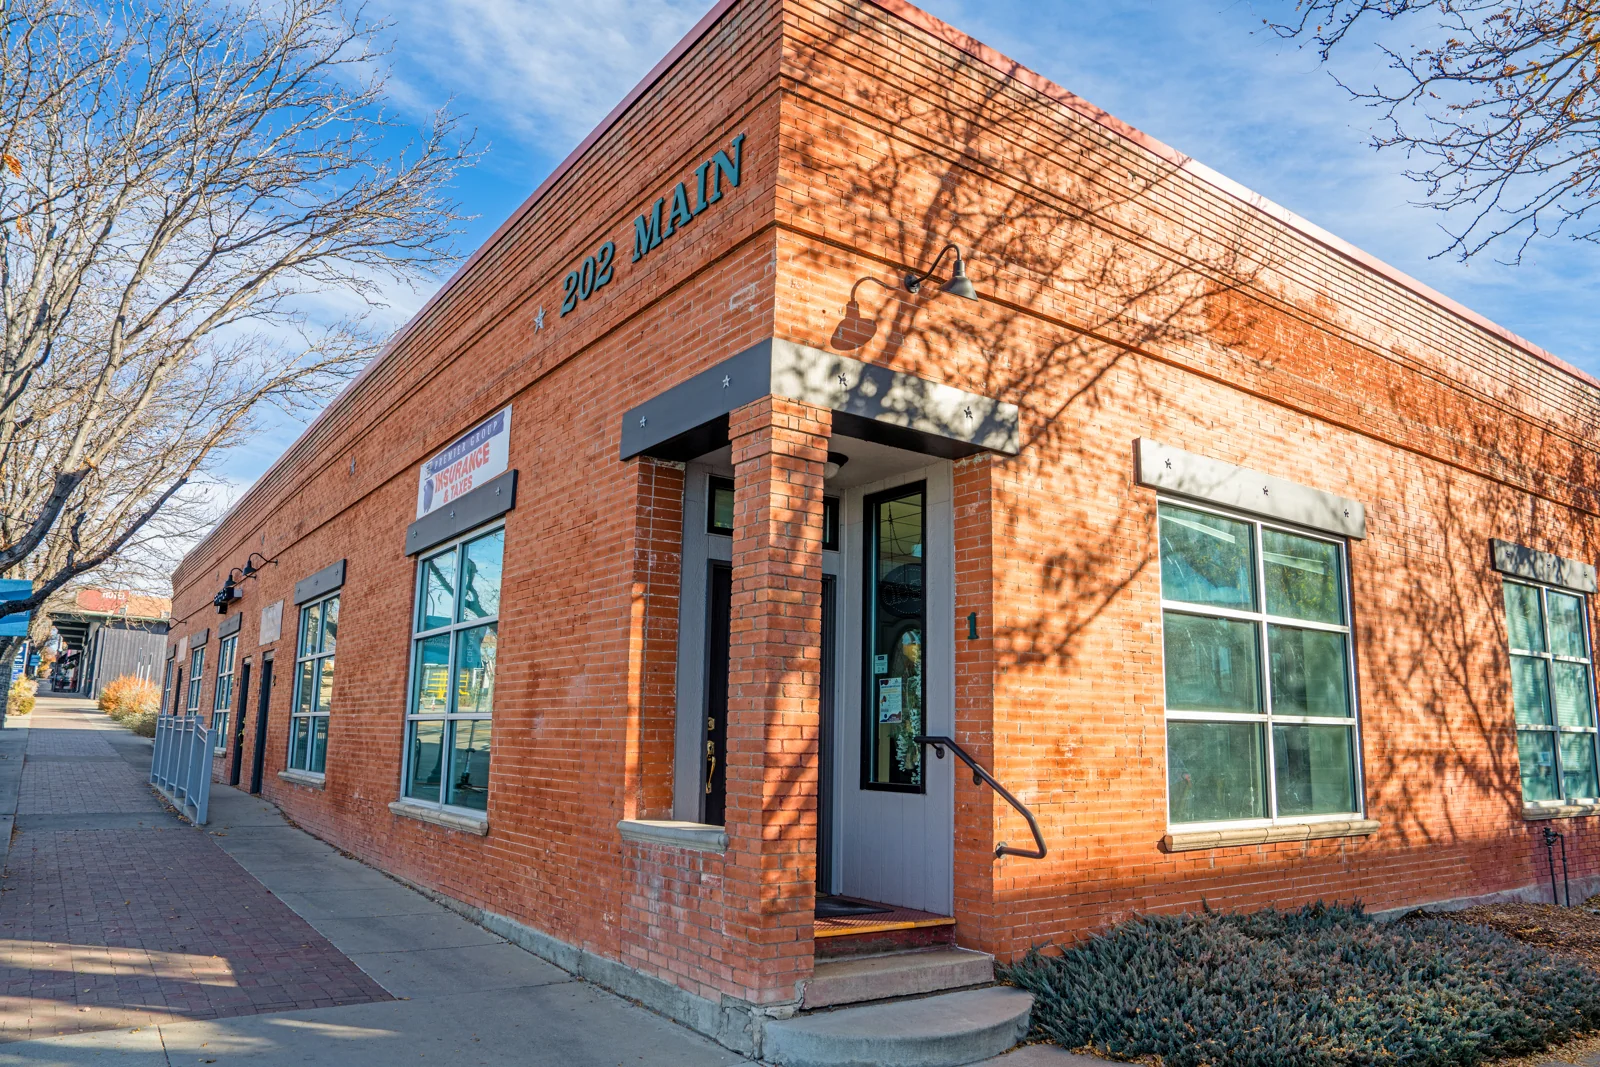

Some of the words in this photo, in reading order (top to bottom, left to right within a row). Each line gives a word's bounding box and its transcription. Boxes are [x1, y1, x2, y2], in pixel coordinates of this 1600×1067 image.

[560, 241, 615, 318] 202
[632, 133, 745, 263] MAIN
[434, 443, 466, 470] PREMIER
[470, 420, 498, 446] GROUP
[434, 442, 490, 494] INSURANCE
[443, 488, 449, 504] &
[450, 475, 473, 500] TAXES
[967, 611, 979, 640] 1
